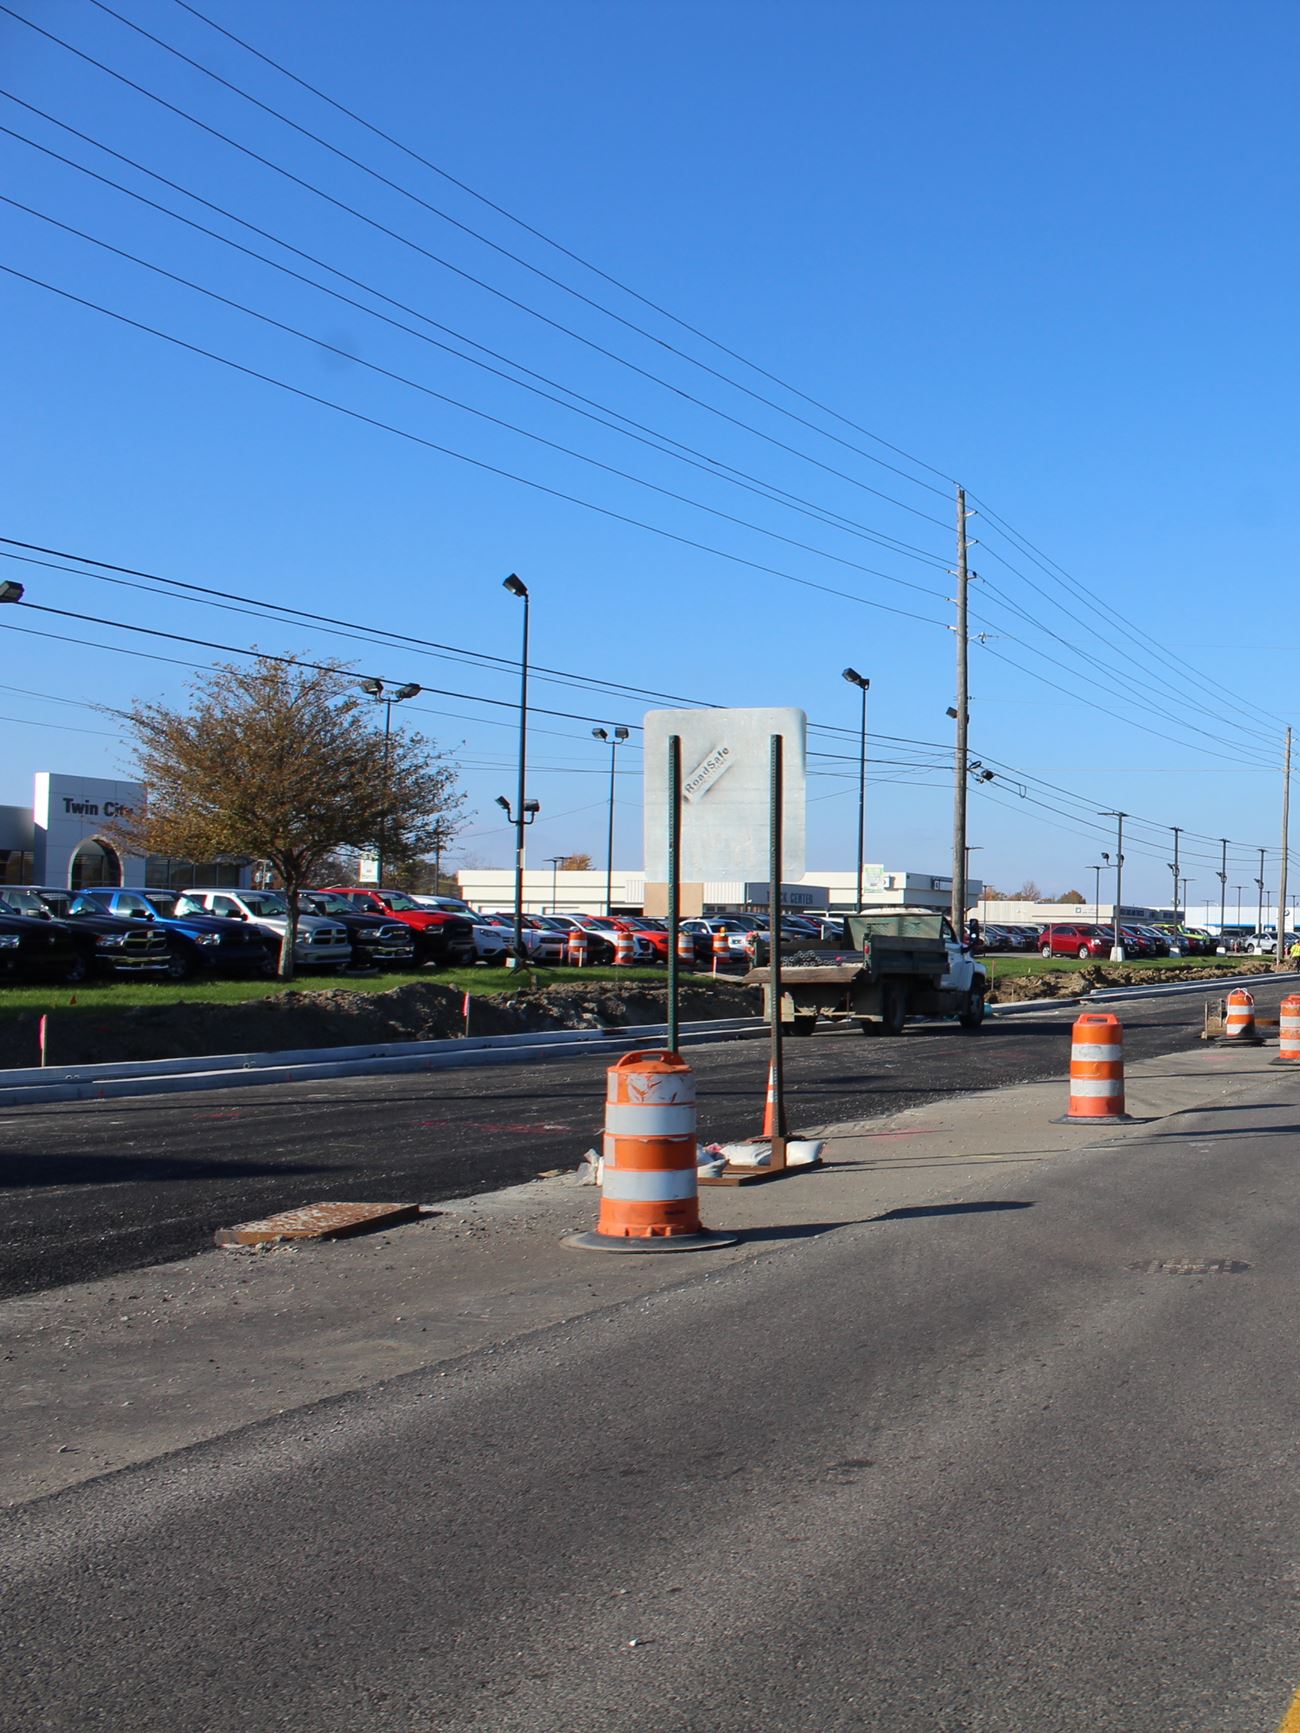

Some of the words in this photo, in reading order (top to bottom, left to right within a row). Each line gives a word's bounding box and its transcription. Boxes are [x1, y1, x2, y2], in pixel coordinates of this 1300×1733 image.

[684, 747, 729, 793] RoadSafe
[63, 797, 99, 815] Twin
[790, 892, 813, 905] CENTER
